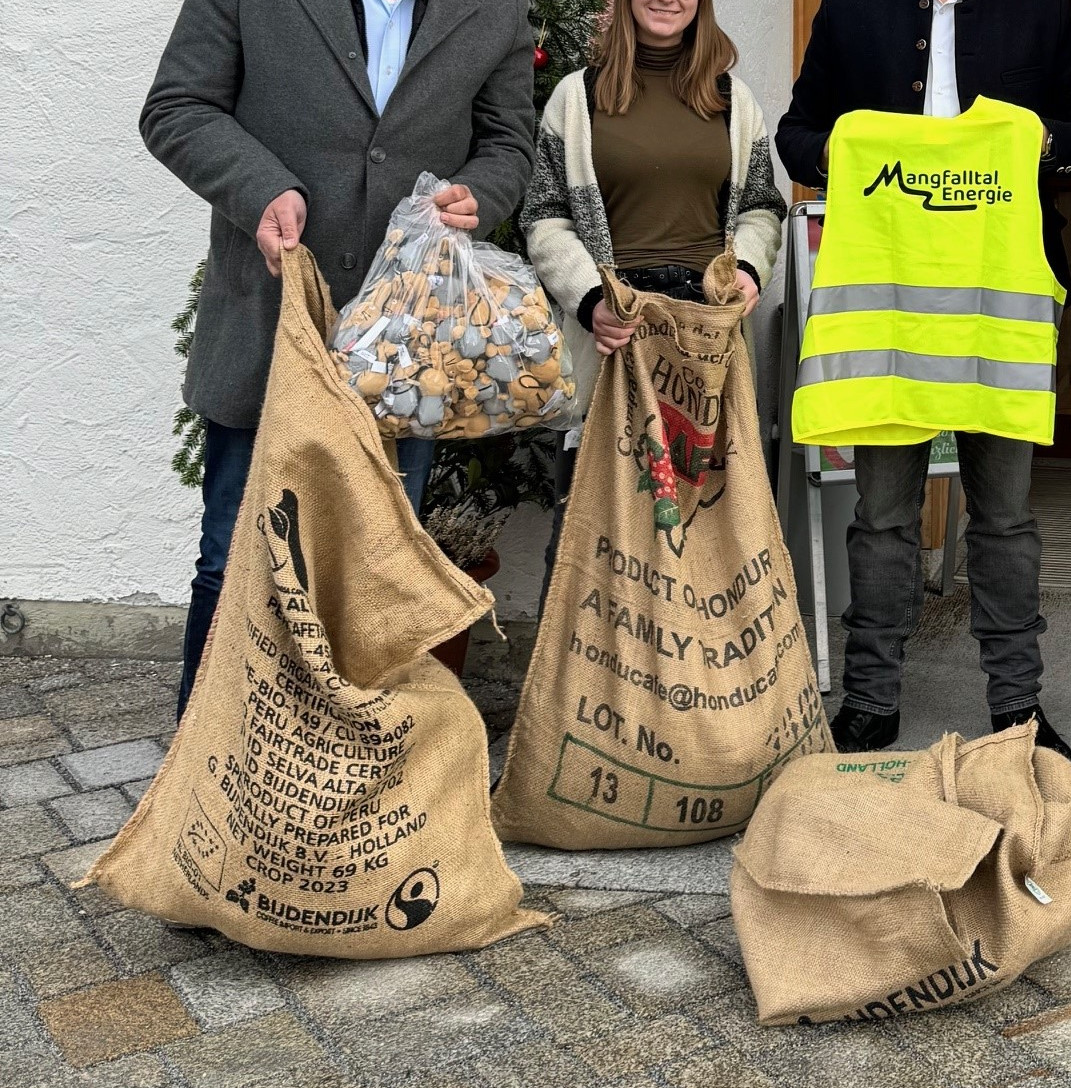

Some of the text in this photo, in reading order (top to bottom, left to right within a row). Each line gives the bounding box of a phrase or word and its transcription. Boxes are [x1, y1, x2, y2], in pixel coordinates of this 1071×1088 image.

[864, 160, 999, 198] Mangfalltal
[942, 186, 1013, 204] Energie
[579, 588, 601, 617] A
[606, 599, 694, 661] FAMLY
[248, 691, 288, 730] PERU
[292, 725, 405, 761] AGRICULTURE
[250, 716, 340, 775] FAIRTRADE
[335, 725, 355, 741] CU
[360, 714, 416, 745] 894082
[576, 695, 681, 765] LOT. No.
[266, 753, 318, 788] SELVA
[322, 778, 367, 796] ALTA
[836, 759, 907, 773] HOLLAND
[314, 815, 340, 829] OF
[341, 799, 381, 825] PERU
[590, 766, 724, 824] 13 108
[227, 809, 388, 879] NET WEIGHT 69 KG
[284, 821, 372, 847] PREPARED
[378, 804, 411, 830] FOR
[351, 812, 427, 859] HOLLAND
[246, 855, 349, 894] CROP 2023
[258, 893, 380, 927] BIJDENDIJK
